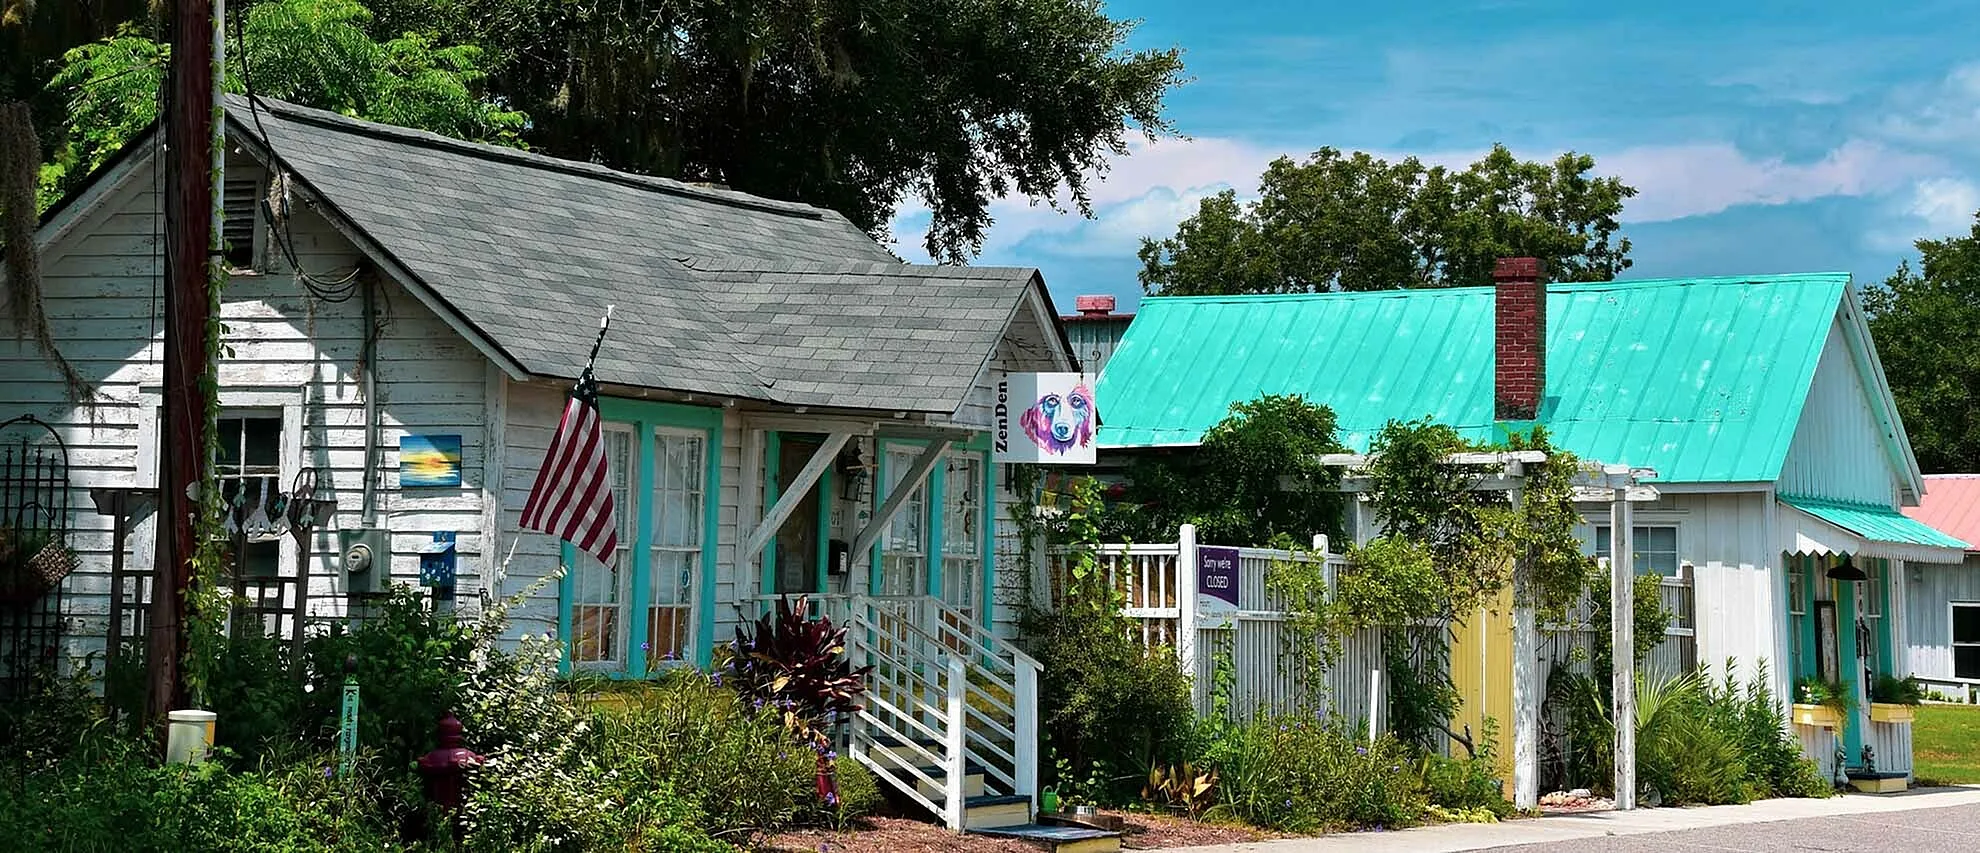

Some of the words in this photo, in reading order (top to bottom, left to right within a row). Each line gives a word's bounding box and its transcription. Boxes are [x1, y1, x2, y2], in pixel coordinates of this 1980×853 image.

[995, 381, 1008, 453] ZenDen
[1203, 555, 1217, 572] Sorry
[1218, 556, 1231, 570] we're
[1206, 575, 1229, 589] CLOSED
